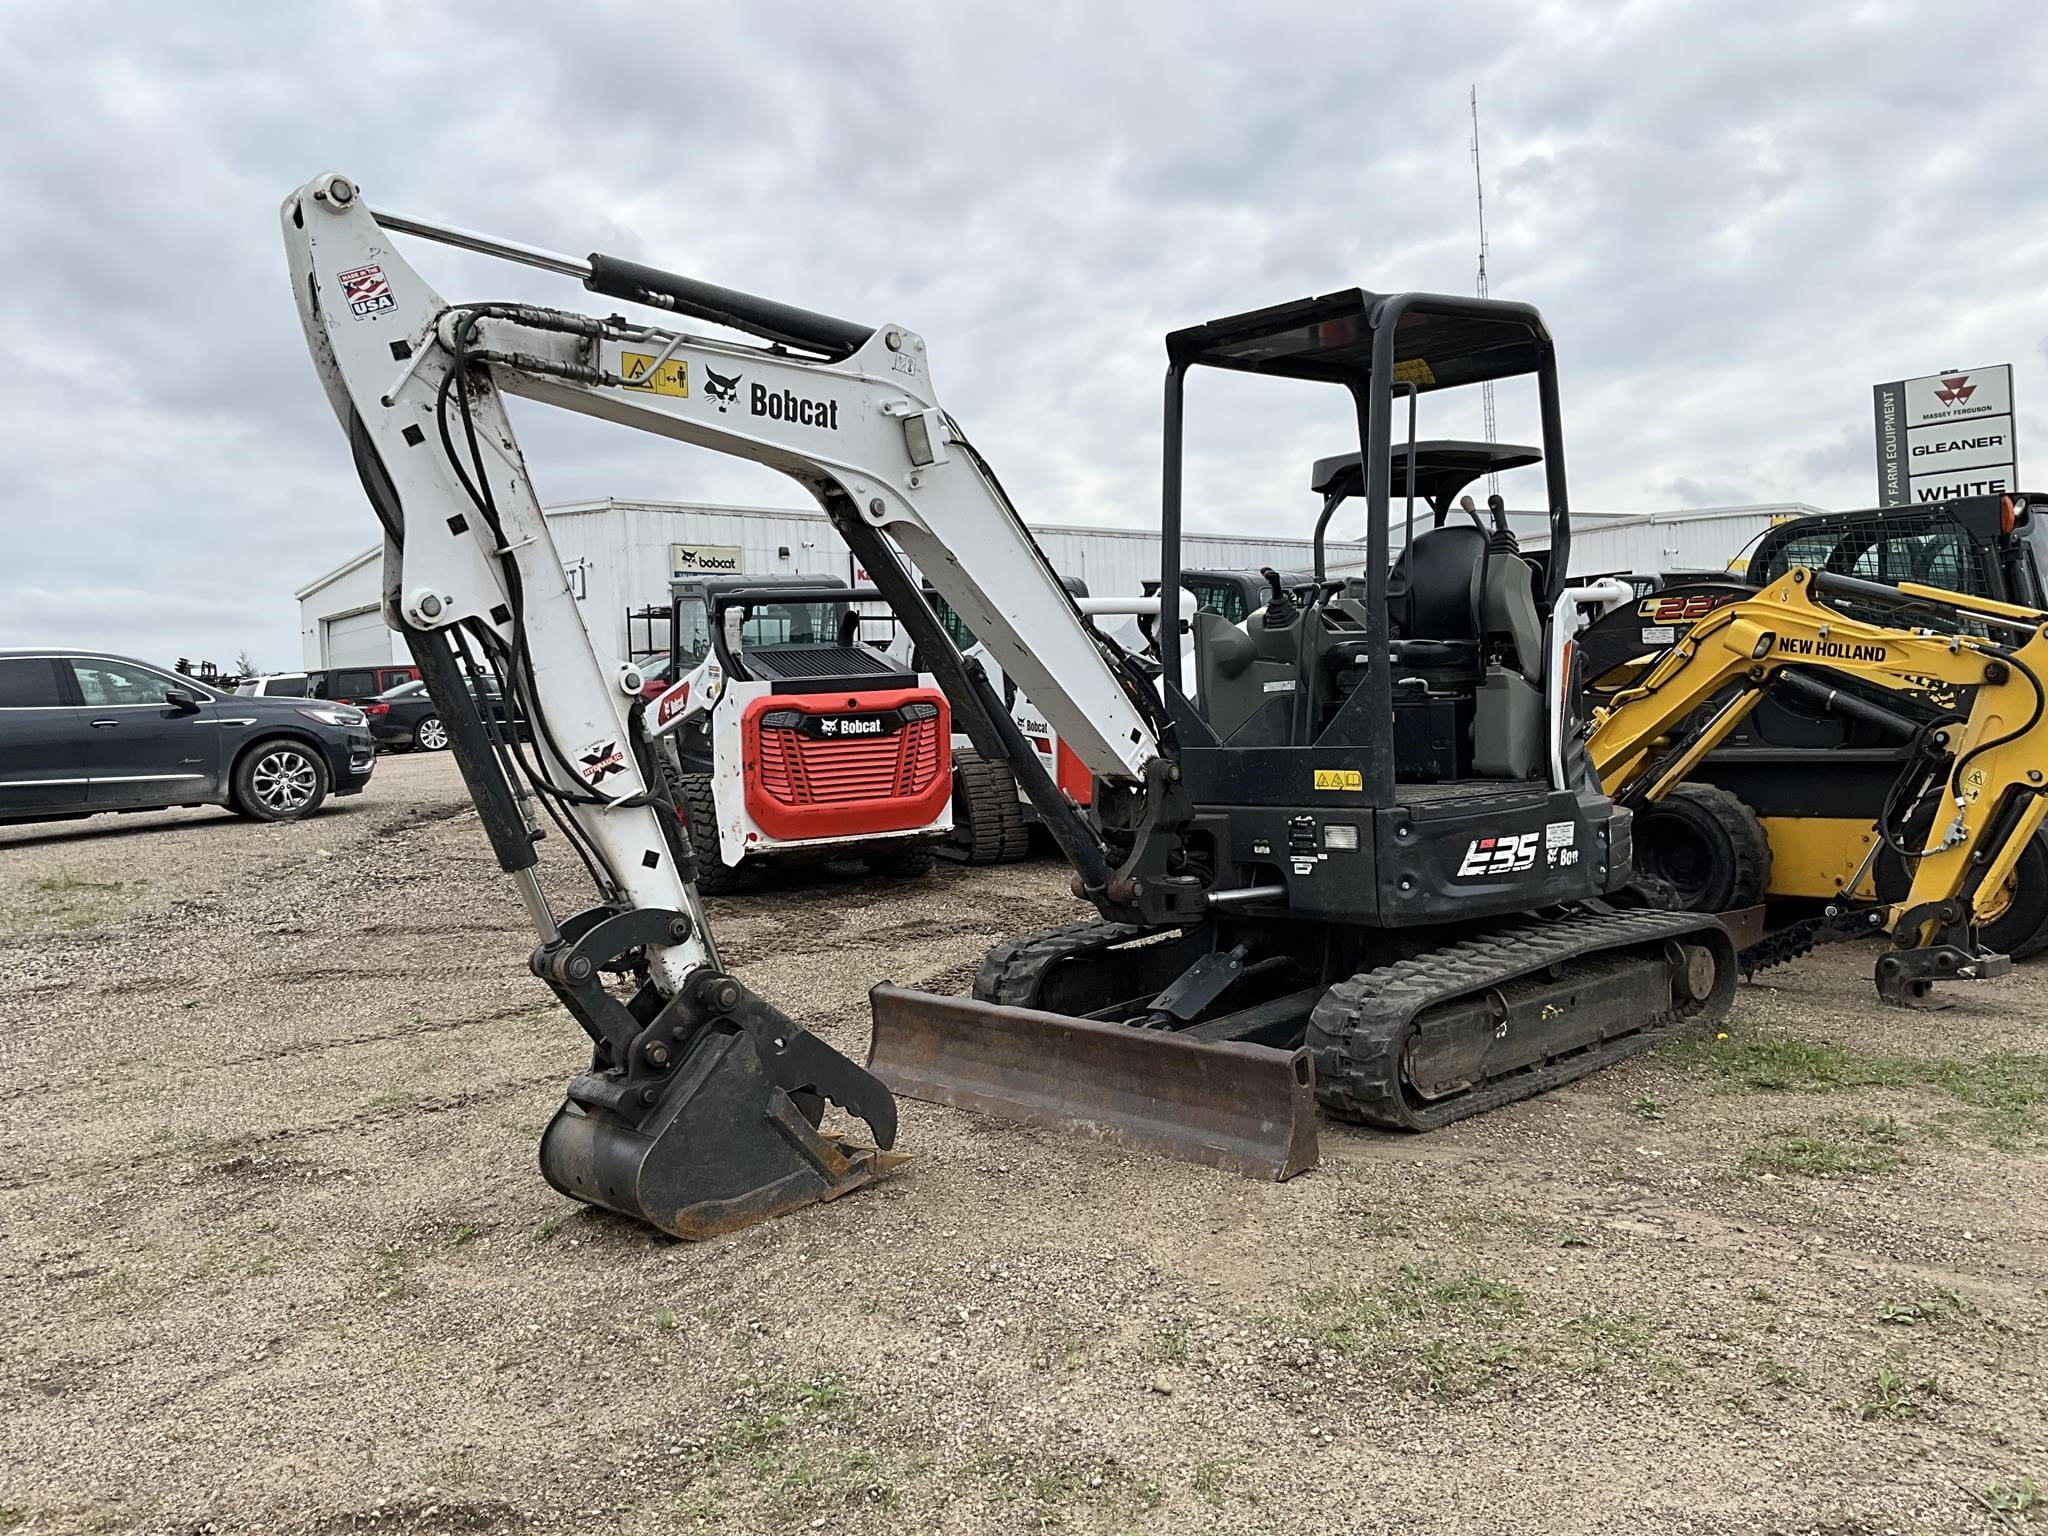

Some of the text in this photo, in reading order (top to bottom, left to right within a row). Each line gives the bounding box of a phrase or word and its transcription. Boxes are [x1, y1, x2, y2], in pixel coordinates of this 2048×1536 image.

[341, 272, 359, 281] MADE
[353, 296, 393, 315] USA
[751, 383, 838, 430] Bobcat
[1922, 405, 1993, 420] MASSEY FERGUSON
[1883, 392, 1897, 461] EQUIPMENT
[1912, 435, 2003, 457] GLEANER
[1887, 463, 1900, 495] FARM
[1917, 480, 2006, 502] WHITE
[698, 556, 736, 569] bobcat
[1779, 637, 1887, 662] NEW HOLLAND
[841, 719, 881, 734] Bobcat
[1026, 719, 1048, 734] Bobcat
[1457, 832, 1540, 877] E35
